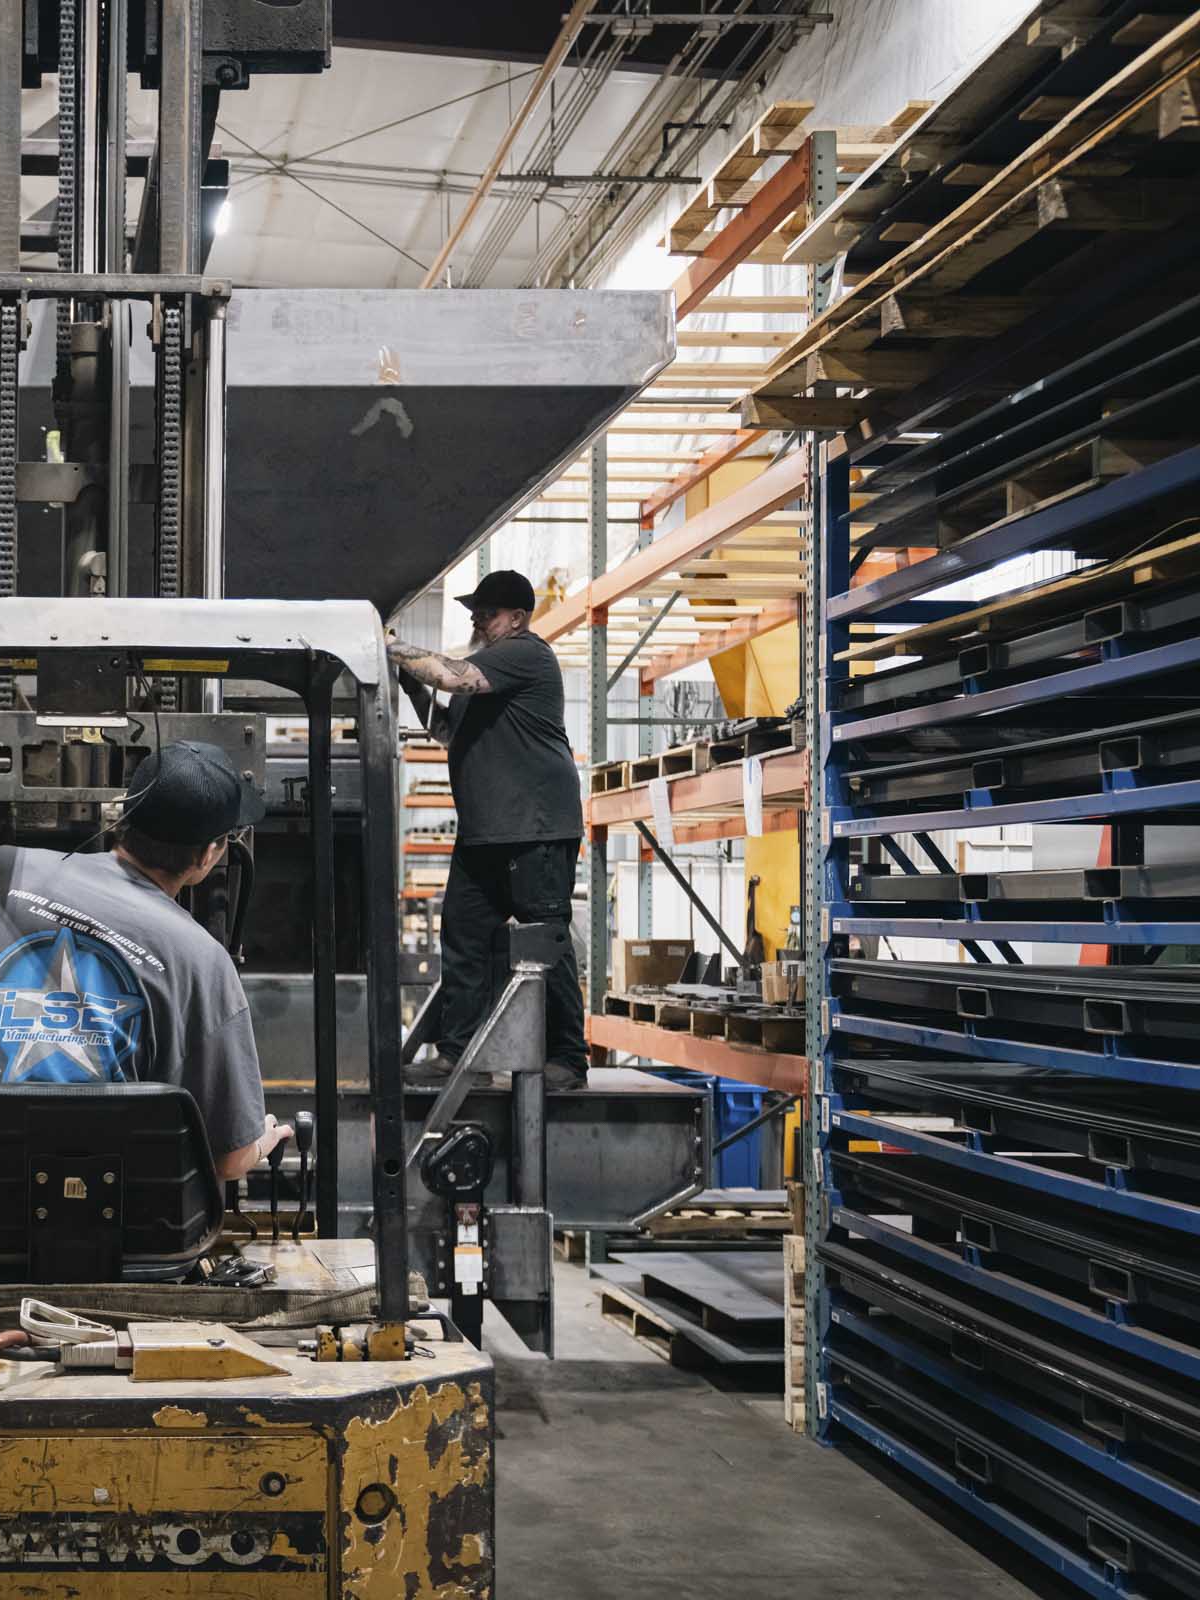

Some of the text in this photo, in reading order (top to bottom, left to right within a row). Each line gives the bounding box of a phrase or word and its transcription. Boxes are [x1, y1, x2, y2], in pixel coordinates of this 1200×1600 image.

[7, 888, 49, 906] PROUD
[28, 905, 60, 922] LONE
[60, 917, 90, 933] STAR
[0, 991, 120, 1034] LSE
